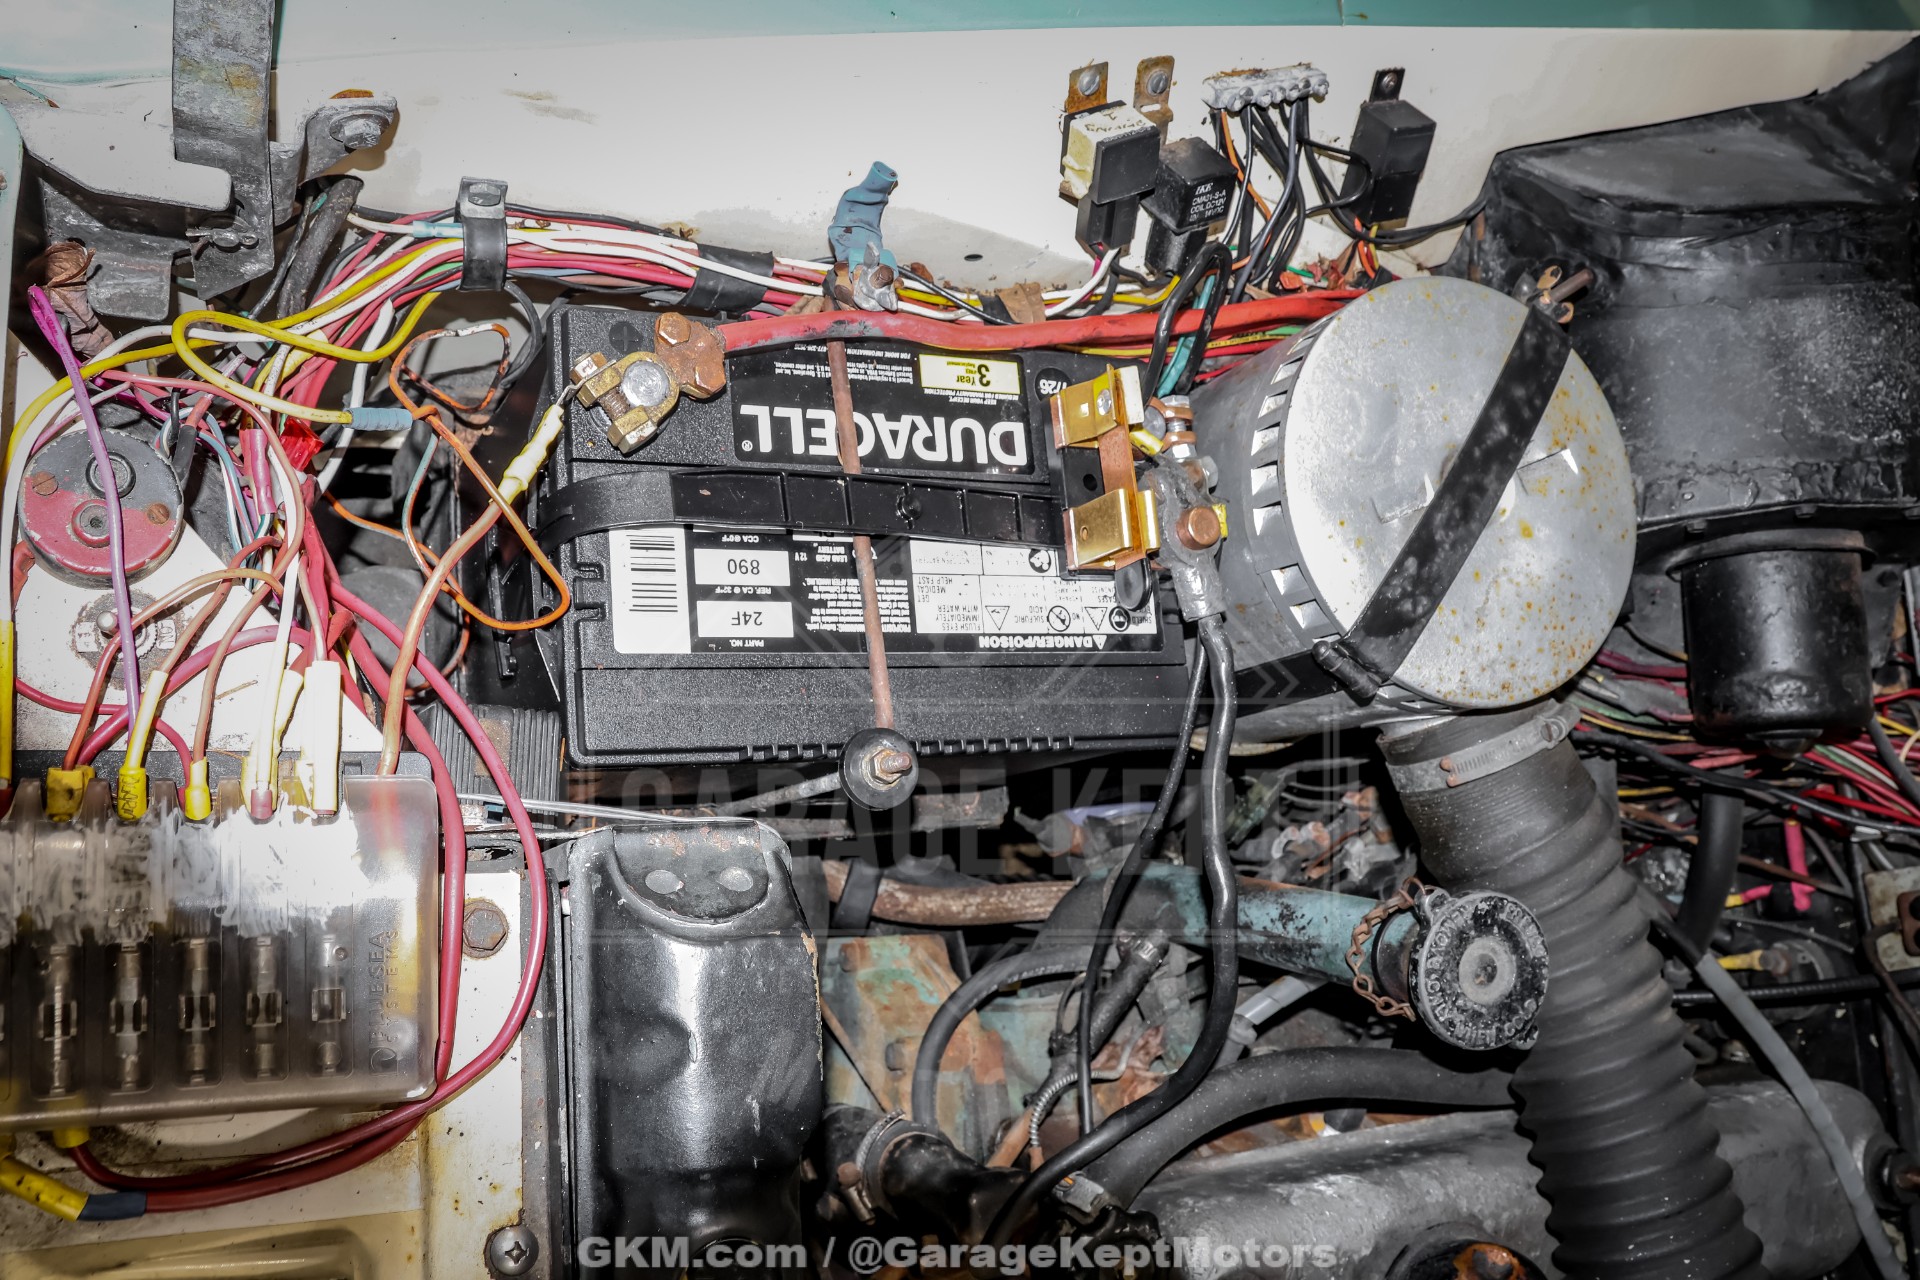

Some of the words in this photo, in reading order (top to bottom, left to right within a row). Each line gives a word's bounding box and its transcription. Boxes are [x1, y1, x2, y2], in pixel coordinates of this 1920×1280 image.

[977, 364, 991, 387] 3
[956, 376, 976, 386] Year
[742, 535, 759, 543] CCA
[817, 546, 845, 554] BATTERY
[727, 559, 760, 575] 890
[918, 576, 934, 584] FAST
[936, 576, 952, 584] HELP
[917, 585, 946, 593] MEDICAL
[917, 594, 930, 602] GET
[731, 611, 763, 626] 24F
[936, 614, 980, 622] IMMEDIATELY
[1014, 615, 1044, 623] SULFURIC
[729, 639, 743, 647] NO.
[744, 639, 765, 647] PART
[979, 635, 1093, 648] DANGER/POISON
